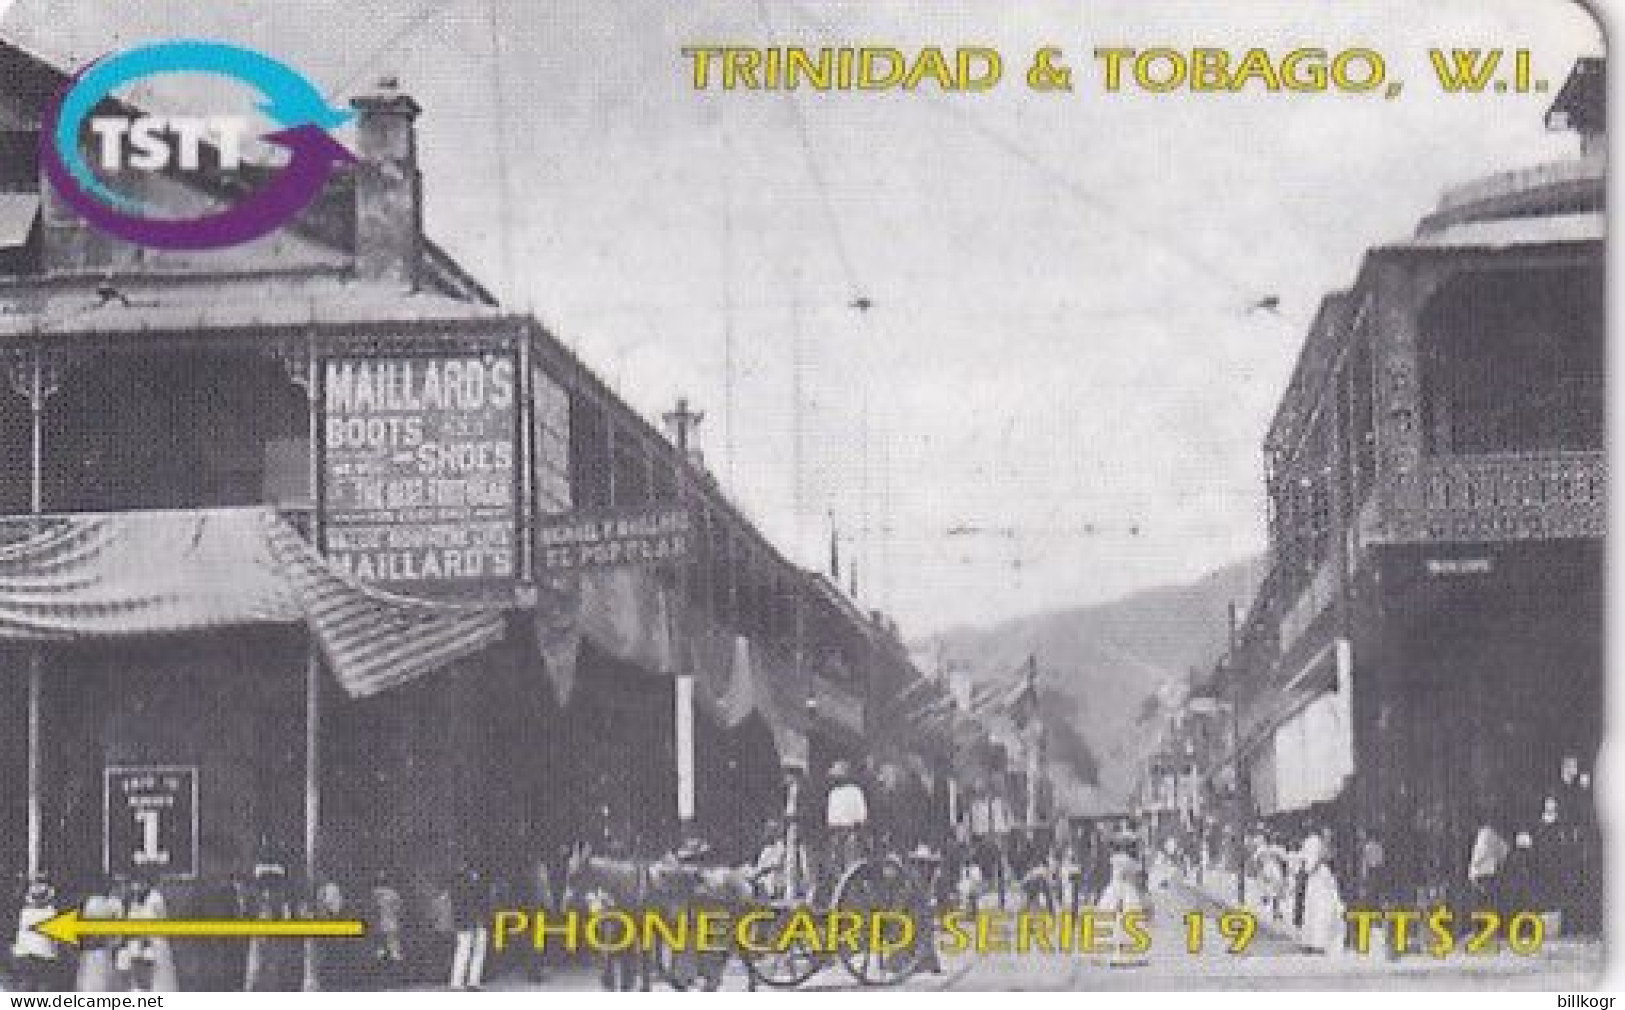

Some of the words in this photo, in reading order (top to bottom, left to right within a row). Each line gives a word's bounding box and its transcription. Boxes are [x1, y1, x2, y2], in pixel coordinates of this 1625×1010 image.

[681, 47, 1004, 90] TRINIDAD
[1026, 47, 1072, 91] &
[1094, 48, 1402, 99] TOBAGO,
[1428, 48, 1549, 92] W.I.
[92, 116, 246, 171] TSTT
[326, 355, 515, 412] MAILLARD'S
[326, 416, 423, 448] BOOTS
[417, 442, 513, 473] SHOES
[327, 549, 514, 580] MAILLARD'S
[492, 909, 916, 953] PHONECARD
[938, 909, 1154, 954] SERIES
[1183, 909, 1259, 954] 19
[1343, 905, 1547, 960] TT$20
